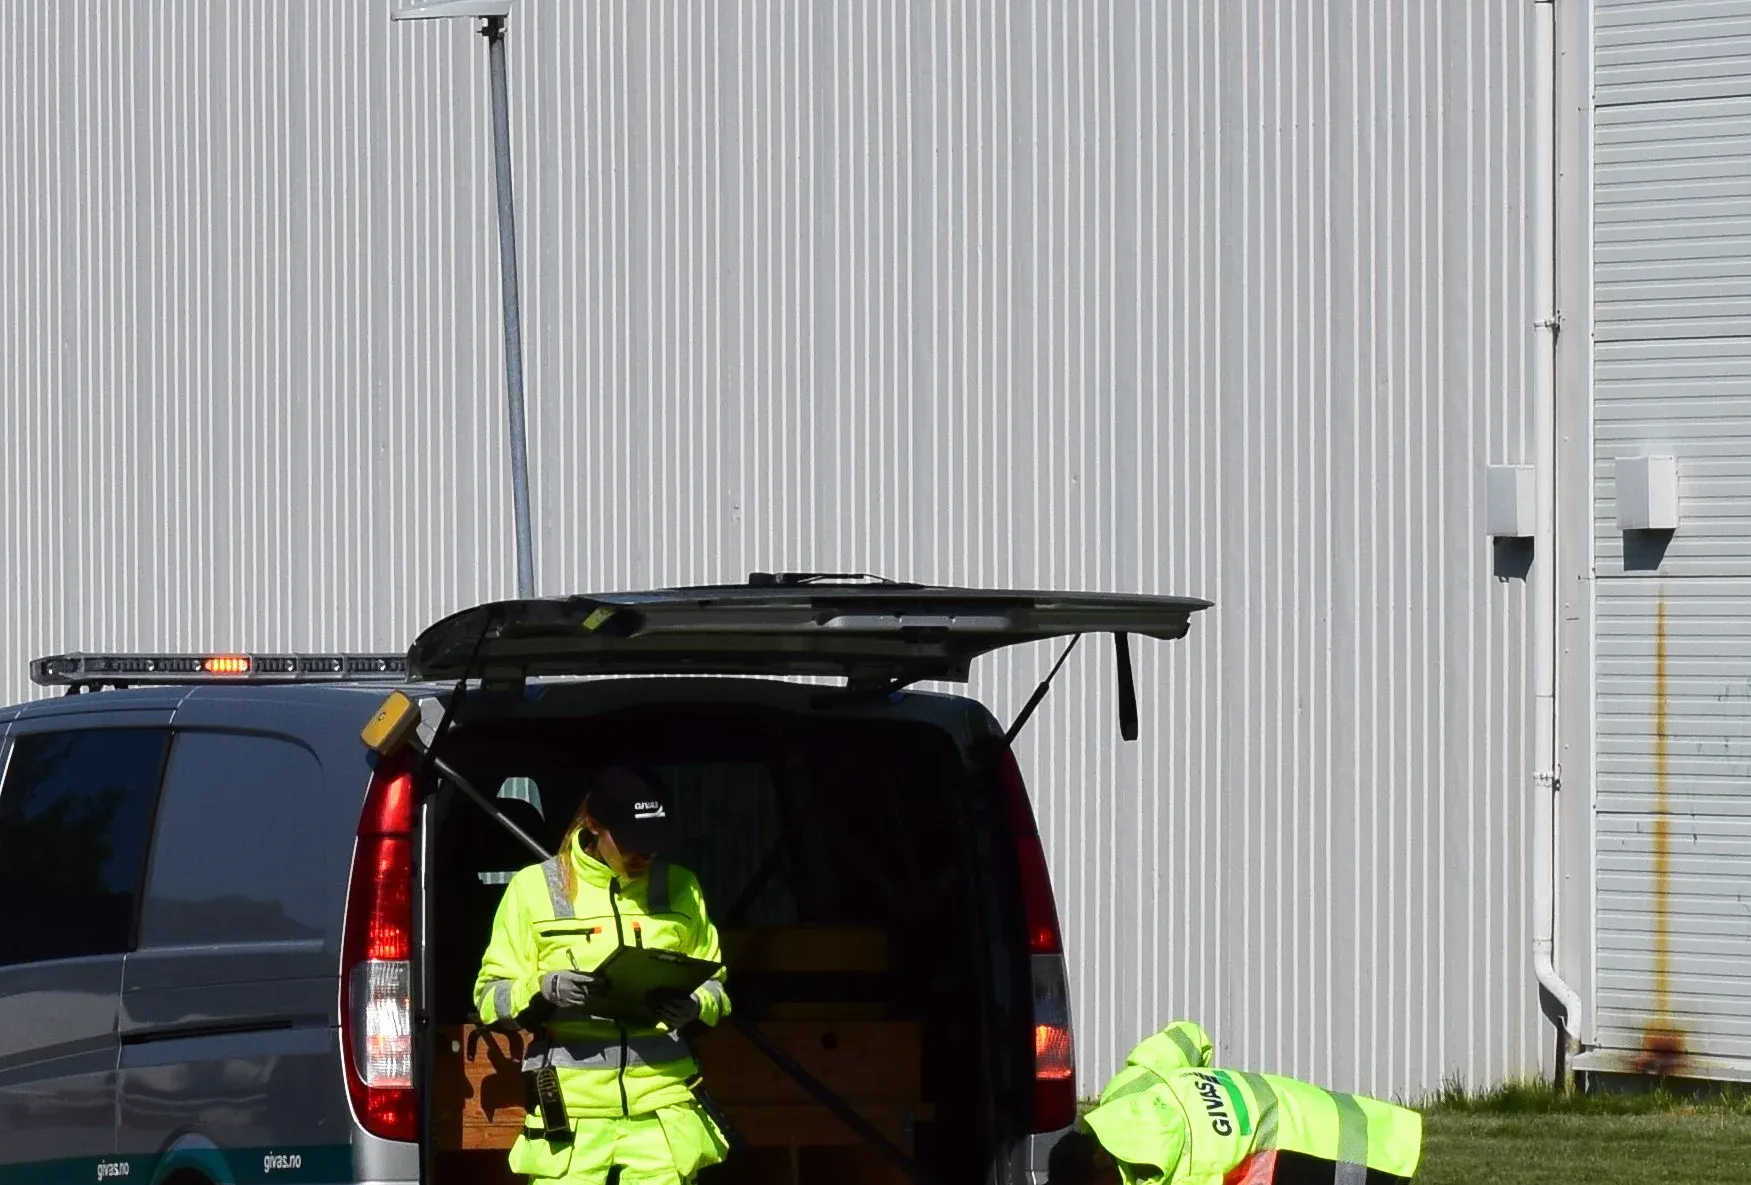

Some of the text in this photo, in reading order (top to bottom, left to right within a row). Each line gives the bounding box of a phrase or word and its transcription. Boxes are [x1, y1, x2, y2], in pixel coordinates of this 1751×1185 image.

[1194, 1080, 1233, 1136] GIVAS
[97, 1159, 130, 1181] givas.no
[263, 1150, 302, 1173] givas.no
